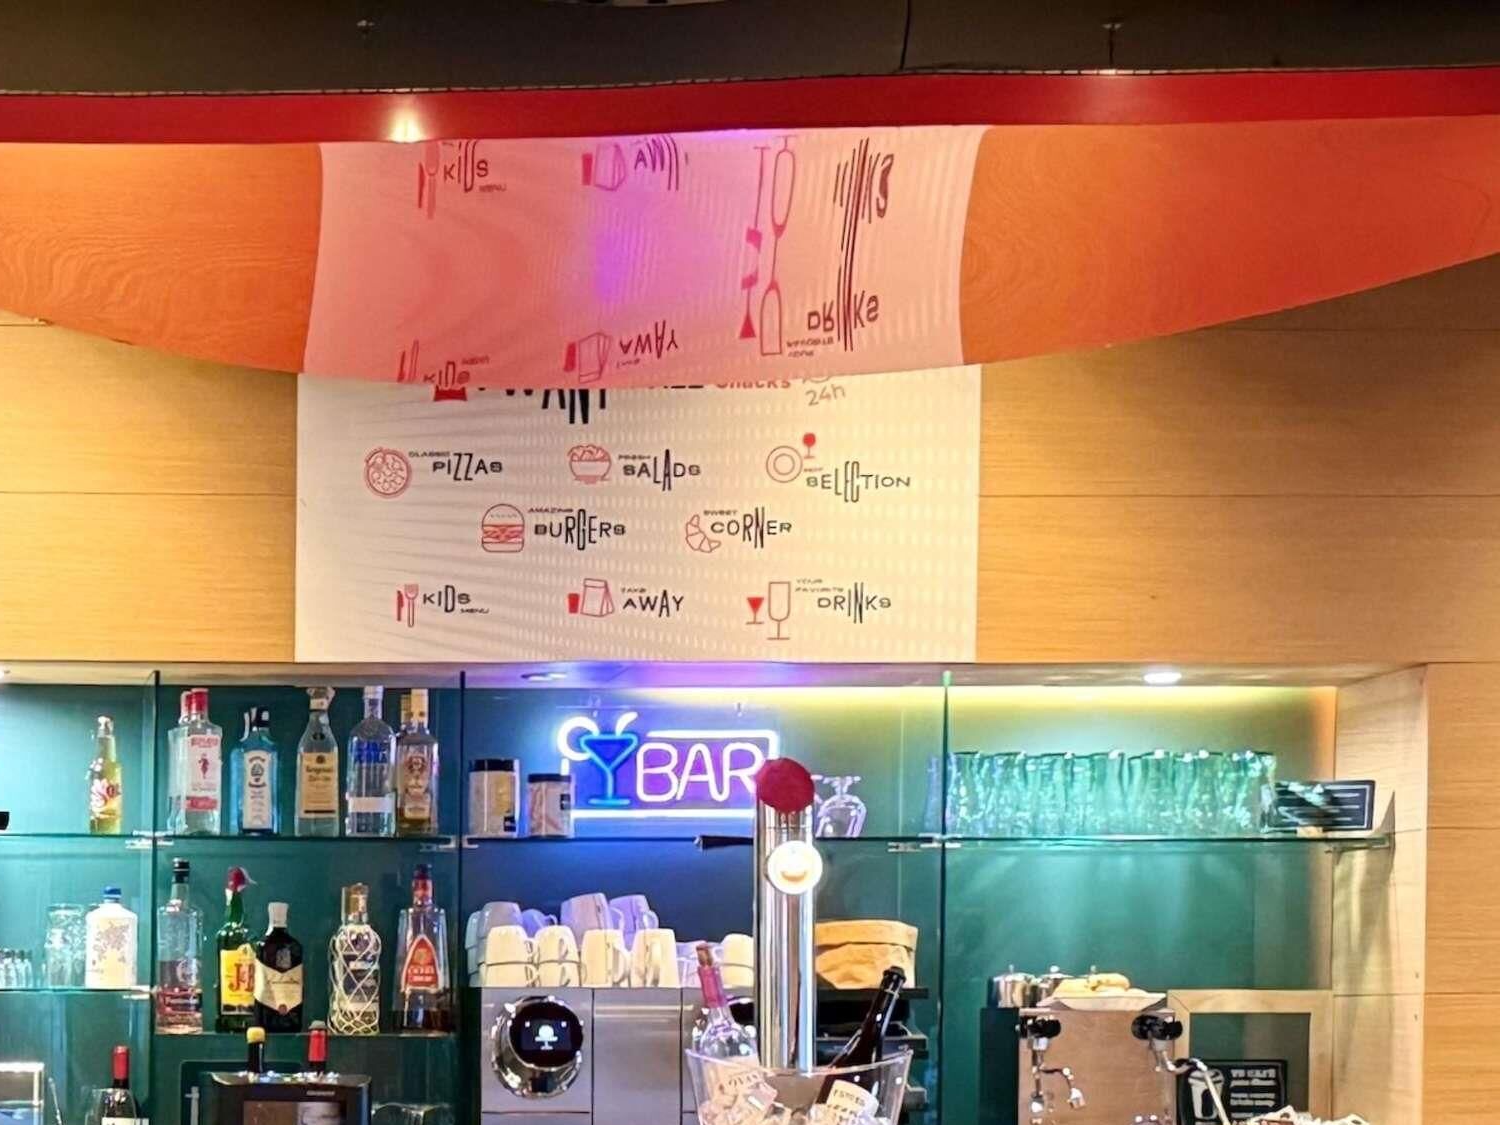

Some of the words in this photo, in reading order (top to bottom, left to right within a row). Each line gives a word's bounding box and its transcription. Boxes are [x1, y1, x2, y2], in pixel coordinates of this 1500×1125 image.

[806, 384, 846, 406] 24h
[432, 453, 503, 481] PIZZAS
[622, 449, 701, 491] SALADS
[806, 461, 911, 502] SELECTION
[534, 509, 626, 550] BURGERS
[710, 507, 792, 548] CORNER
[423, 585, 471, 613] KIDS
[623, 590, 684, 618] AWAY
[817, 582, 891, 623] DRINKS
[637, 742, 765, 803] BAR
